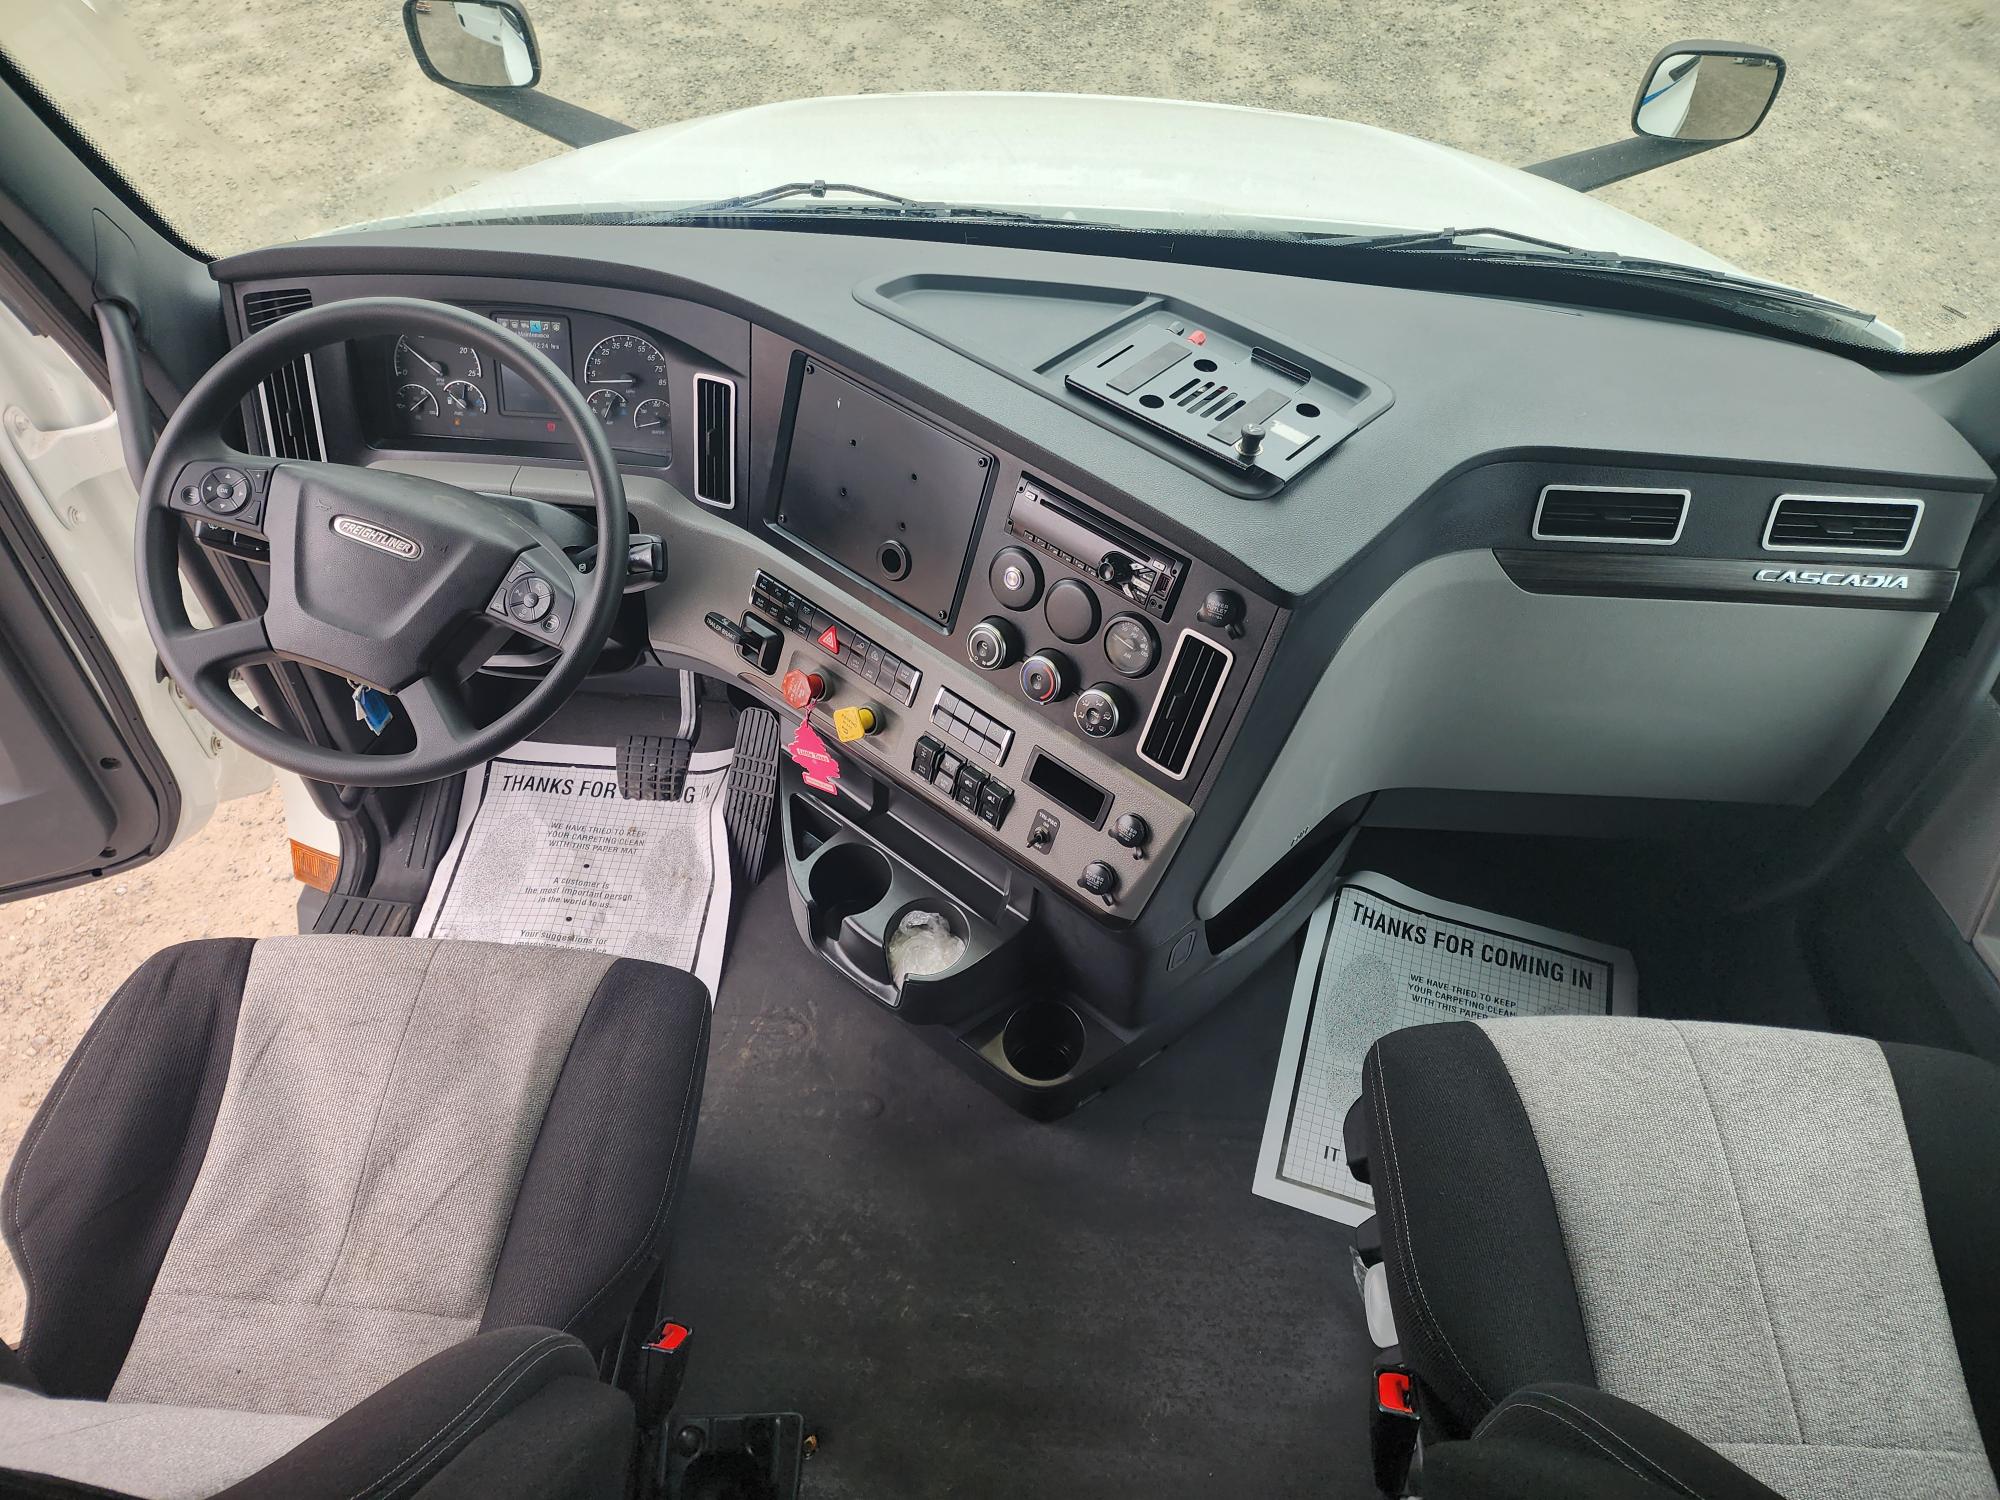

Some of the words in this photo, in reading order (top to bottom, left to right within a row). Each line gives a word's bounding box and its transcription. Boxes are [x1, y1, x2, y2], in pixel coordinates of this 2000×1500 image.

[647, 354, 656, 362] 65
[342, 521, 412, 552] FREIGHTLINER
[1754, 569, 1909, 589] CASCADIA
[502, 775, 574, 796] THANKS
[578, 781, 617, 799] FOR
[701, 782, 713, 800] IN
[548, 830, 570, 840] YOUR
[572, 833, 617, 844] CARPETING
[619, 838, 645, 846] CLEAN
[551, 822, 564, 830] WE
[565, 824, 586, 833] HAVE
[589, 826, 612, 835] TRIED
[614, 828, 624, 836] TO
[626, 830, 647, 838] KEEP
[549, 840, 570, 848] WITH
[572, 842, 590, 851] THIS
[592, 845, 618, 854] PAPER
[561, 878, 600, 889] customer
[602, 882, 610, 890] is
[540, 886, 560, 894] most
[562, 887, 603, 899] important
[604, 893, 633, 902] person
[563, 897, 587, 906] world
[520, 930, 540, 938] Your
[540, 932, 593, 944] suggestions
[596, 936, 608, 945] for
[1352, 901, 1427, 945] THANKS
[1433, 931, 1474, 958] FOR
[1481, 943, 1564, 983] COMING
[1572, 968, 1593, 990] IN
[1408, 983, 1433, 996] YOUR
[1435, 990, 1484, 1010] CARPETING
[1410, 974, 1424, 984] WE
[1426, 978, 1449, 990] HAVE
[1452, 986, 1477, 998] TRIED
[1480, 993, 1492, 1002] TO
[1494, 996, 1516, 1008] KEEP
[1412, 994, 1434, 1007] WITH
[1437, 1002, 1457, 1014] THIS
[1324, 1146, 1341, 1162] IT
